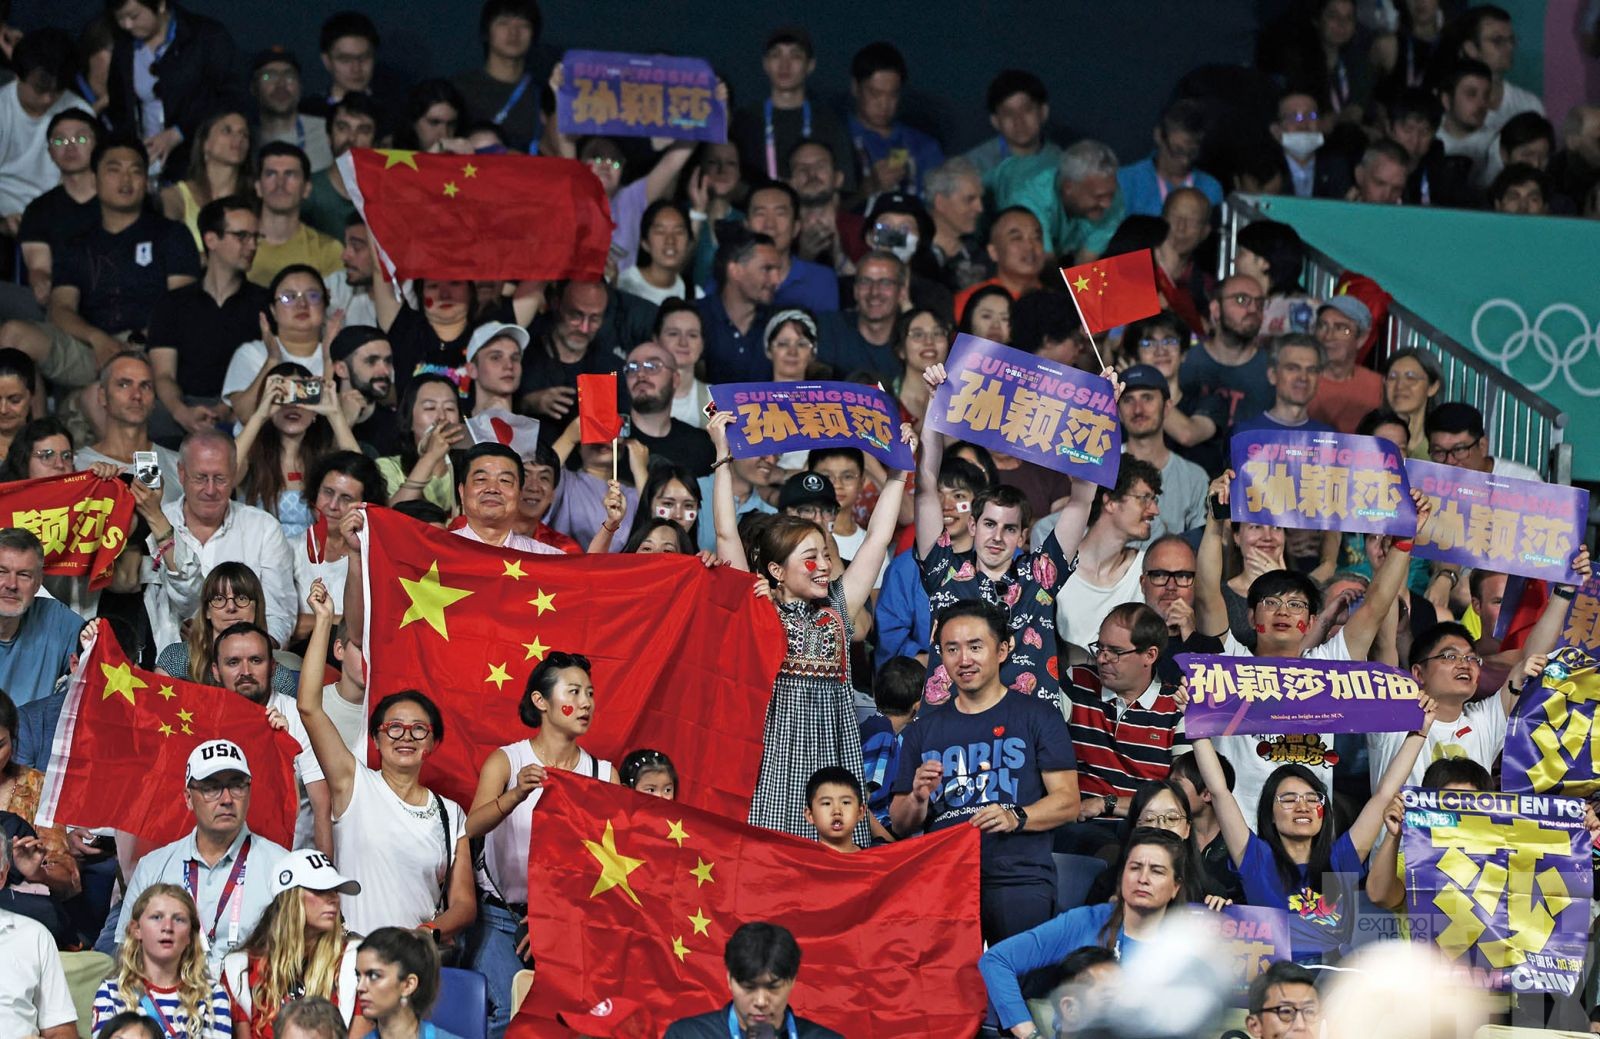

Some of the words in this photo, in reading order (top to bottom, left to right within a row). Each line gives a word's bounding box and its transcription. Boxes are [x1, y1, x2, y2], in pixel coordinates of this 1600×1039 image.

[737, 403, 893, 449] 孙颖莎
[946, 370, 1117, 464] 孙颖莎
[1245, 460, 1402, 522] 孙颖莎
[1415, 496, 1573, 567] 孙颖莎
[1189, 663, 1420, 704] 孙颖莎加油
[202, 743, 242, 761] USA
[1402, 789, 1438, 809] ON
[1442, 792, 1514, 812] CROIT
[1521, 795, 1549, 816] EN
[1431, 815, 1572, 969] 莎
